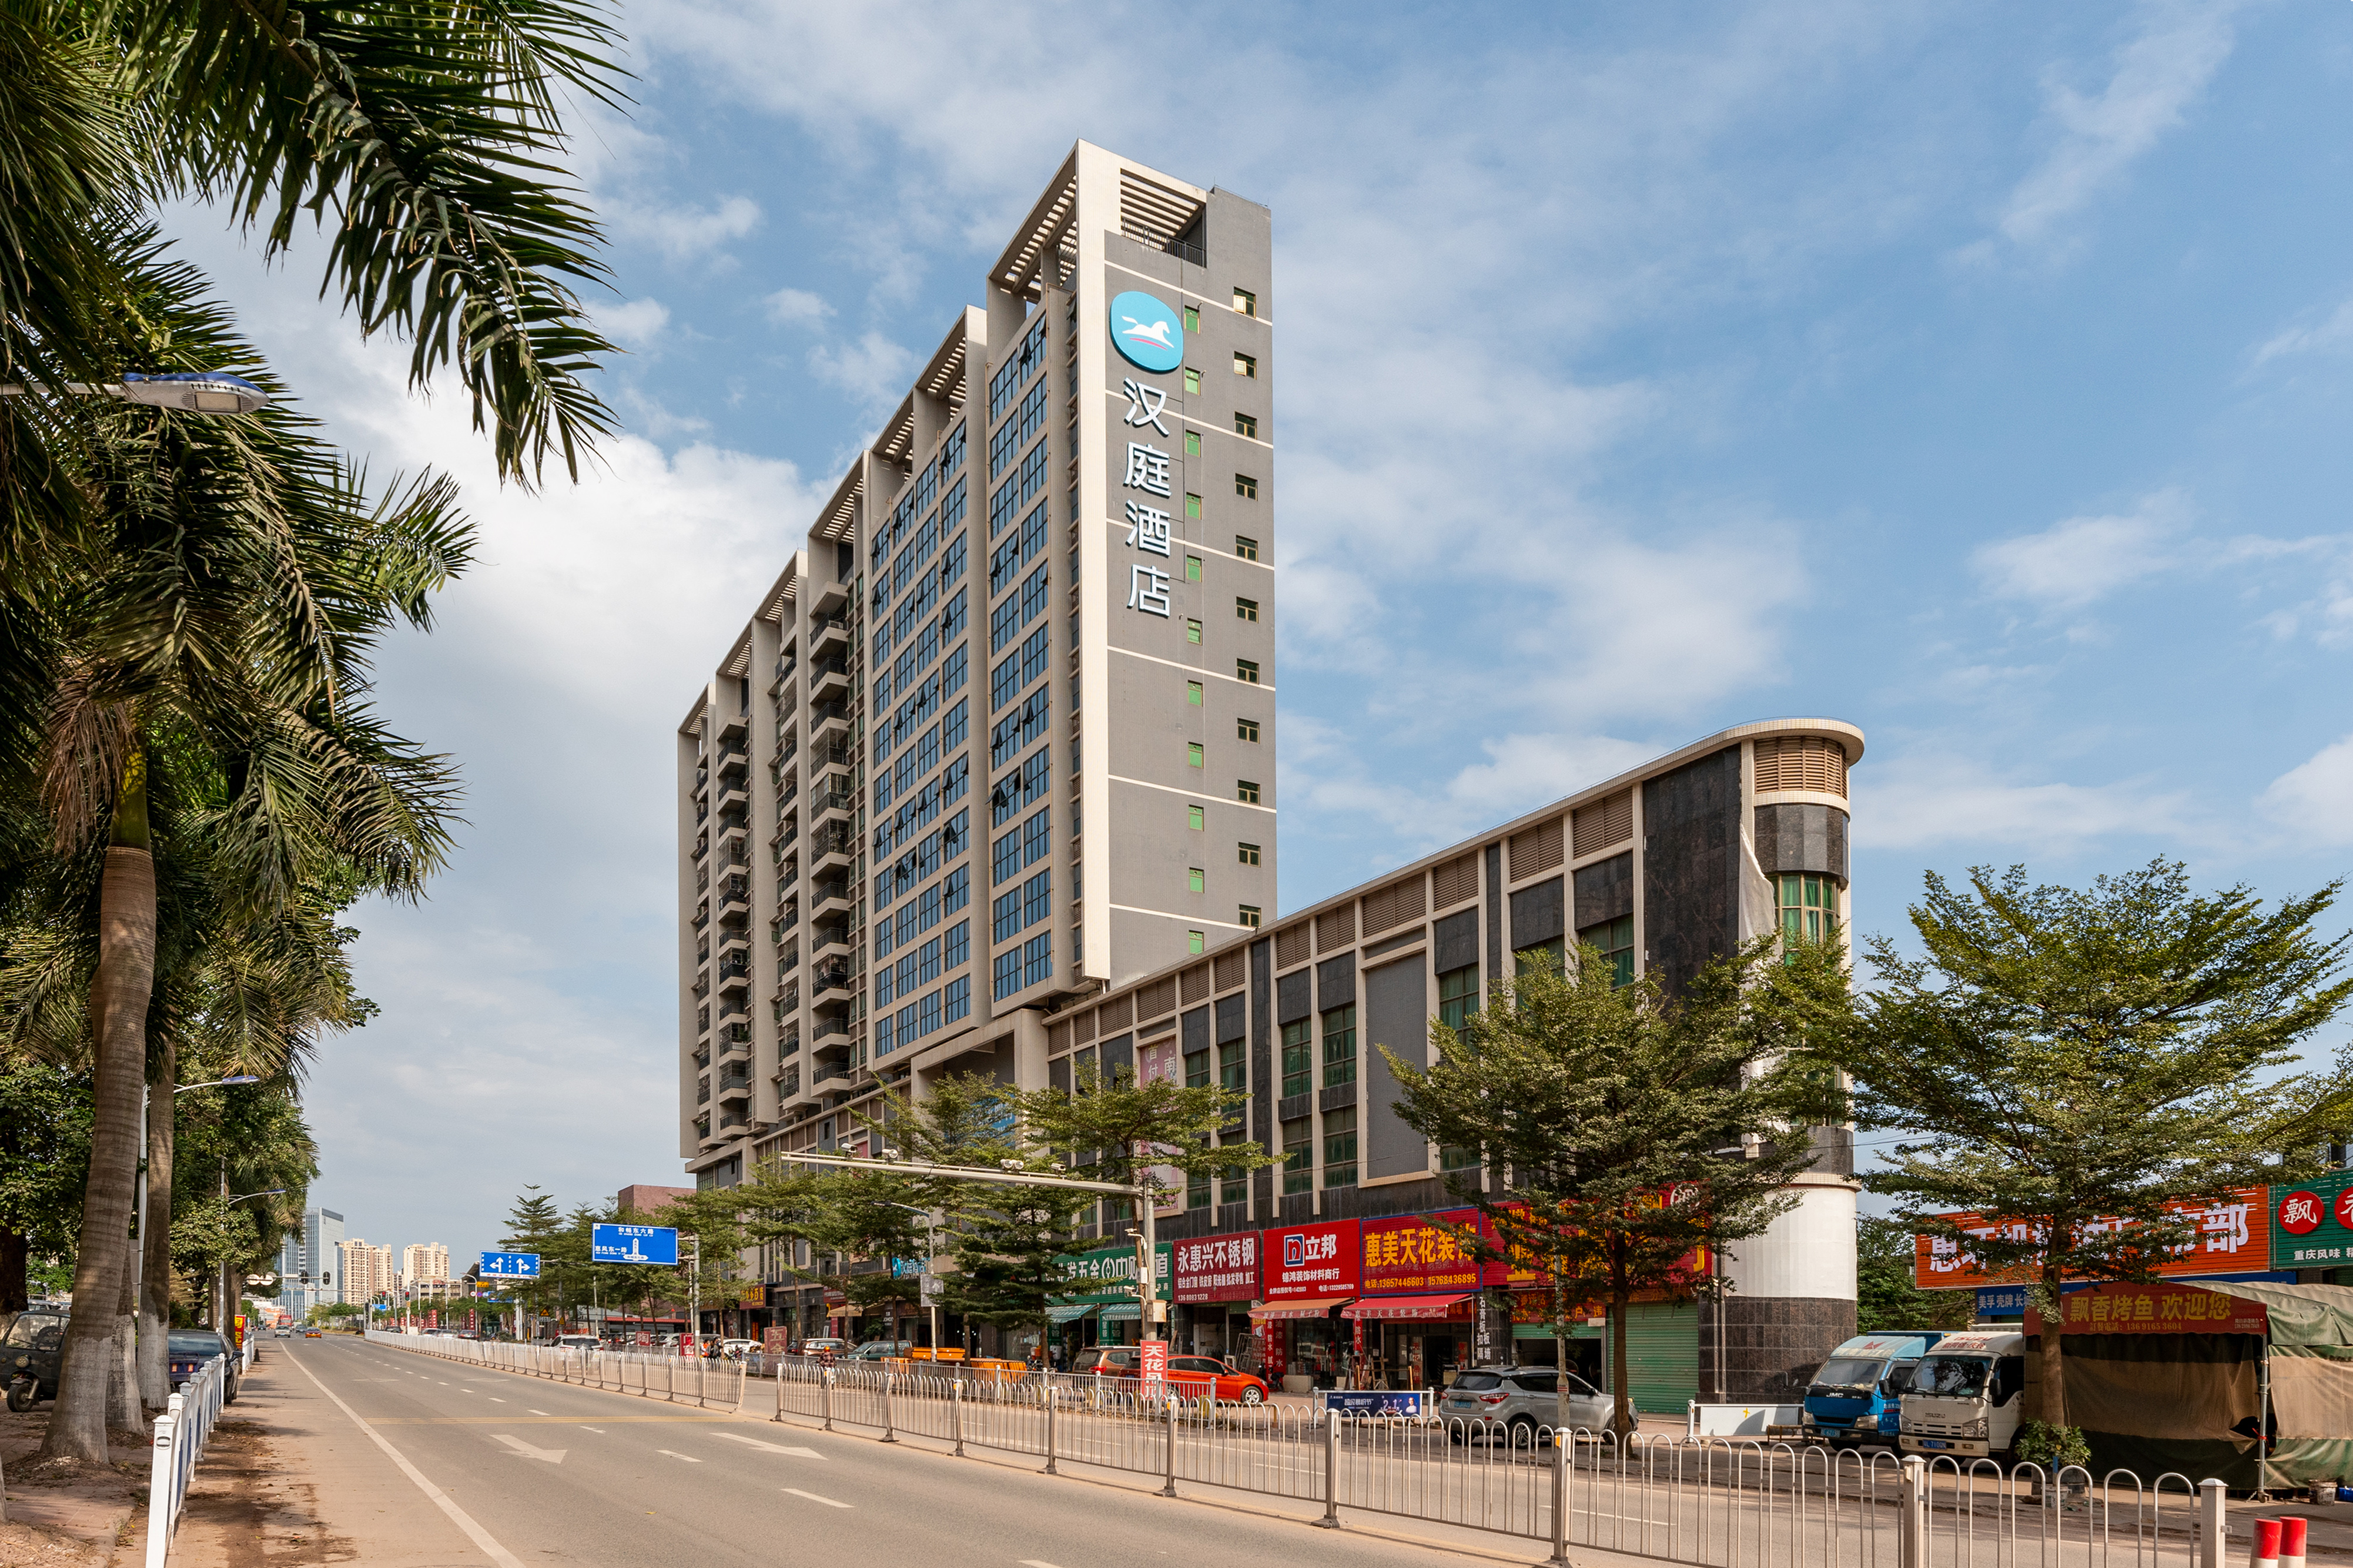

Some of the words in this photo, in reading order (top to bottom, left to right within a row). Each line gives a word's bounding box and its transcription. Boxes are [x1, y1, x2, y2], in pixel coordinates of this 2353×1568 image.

[1123, 376, 1172, 618] 汉庭酒店
[1177, 1238, 1254, 1273] 永惠兴不锈钢
[1306, 1234, 1337, 1260] 立邦
[2294, 1248, 2341, 1261] 重庆风味
[1282, 1268, 1340, 1283] 锦鸿装饰材料商行
[1365, 1277, 1424, 1288] 电话:13657446603
[1428, 1273, 1476, 1285] 15768436895
[1979, 1295, 1995, 1309] 美孚
[1996, 1294, 2013, 1308] 壳牌
[2070, 1294, 2154, 1322] 飘香烤鱼
[2161, 1292, 2232, 1321] 欢迎您
